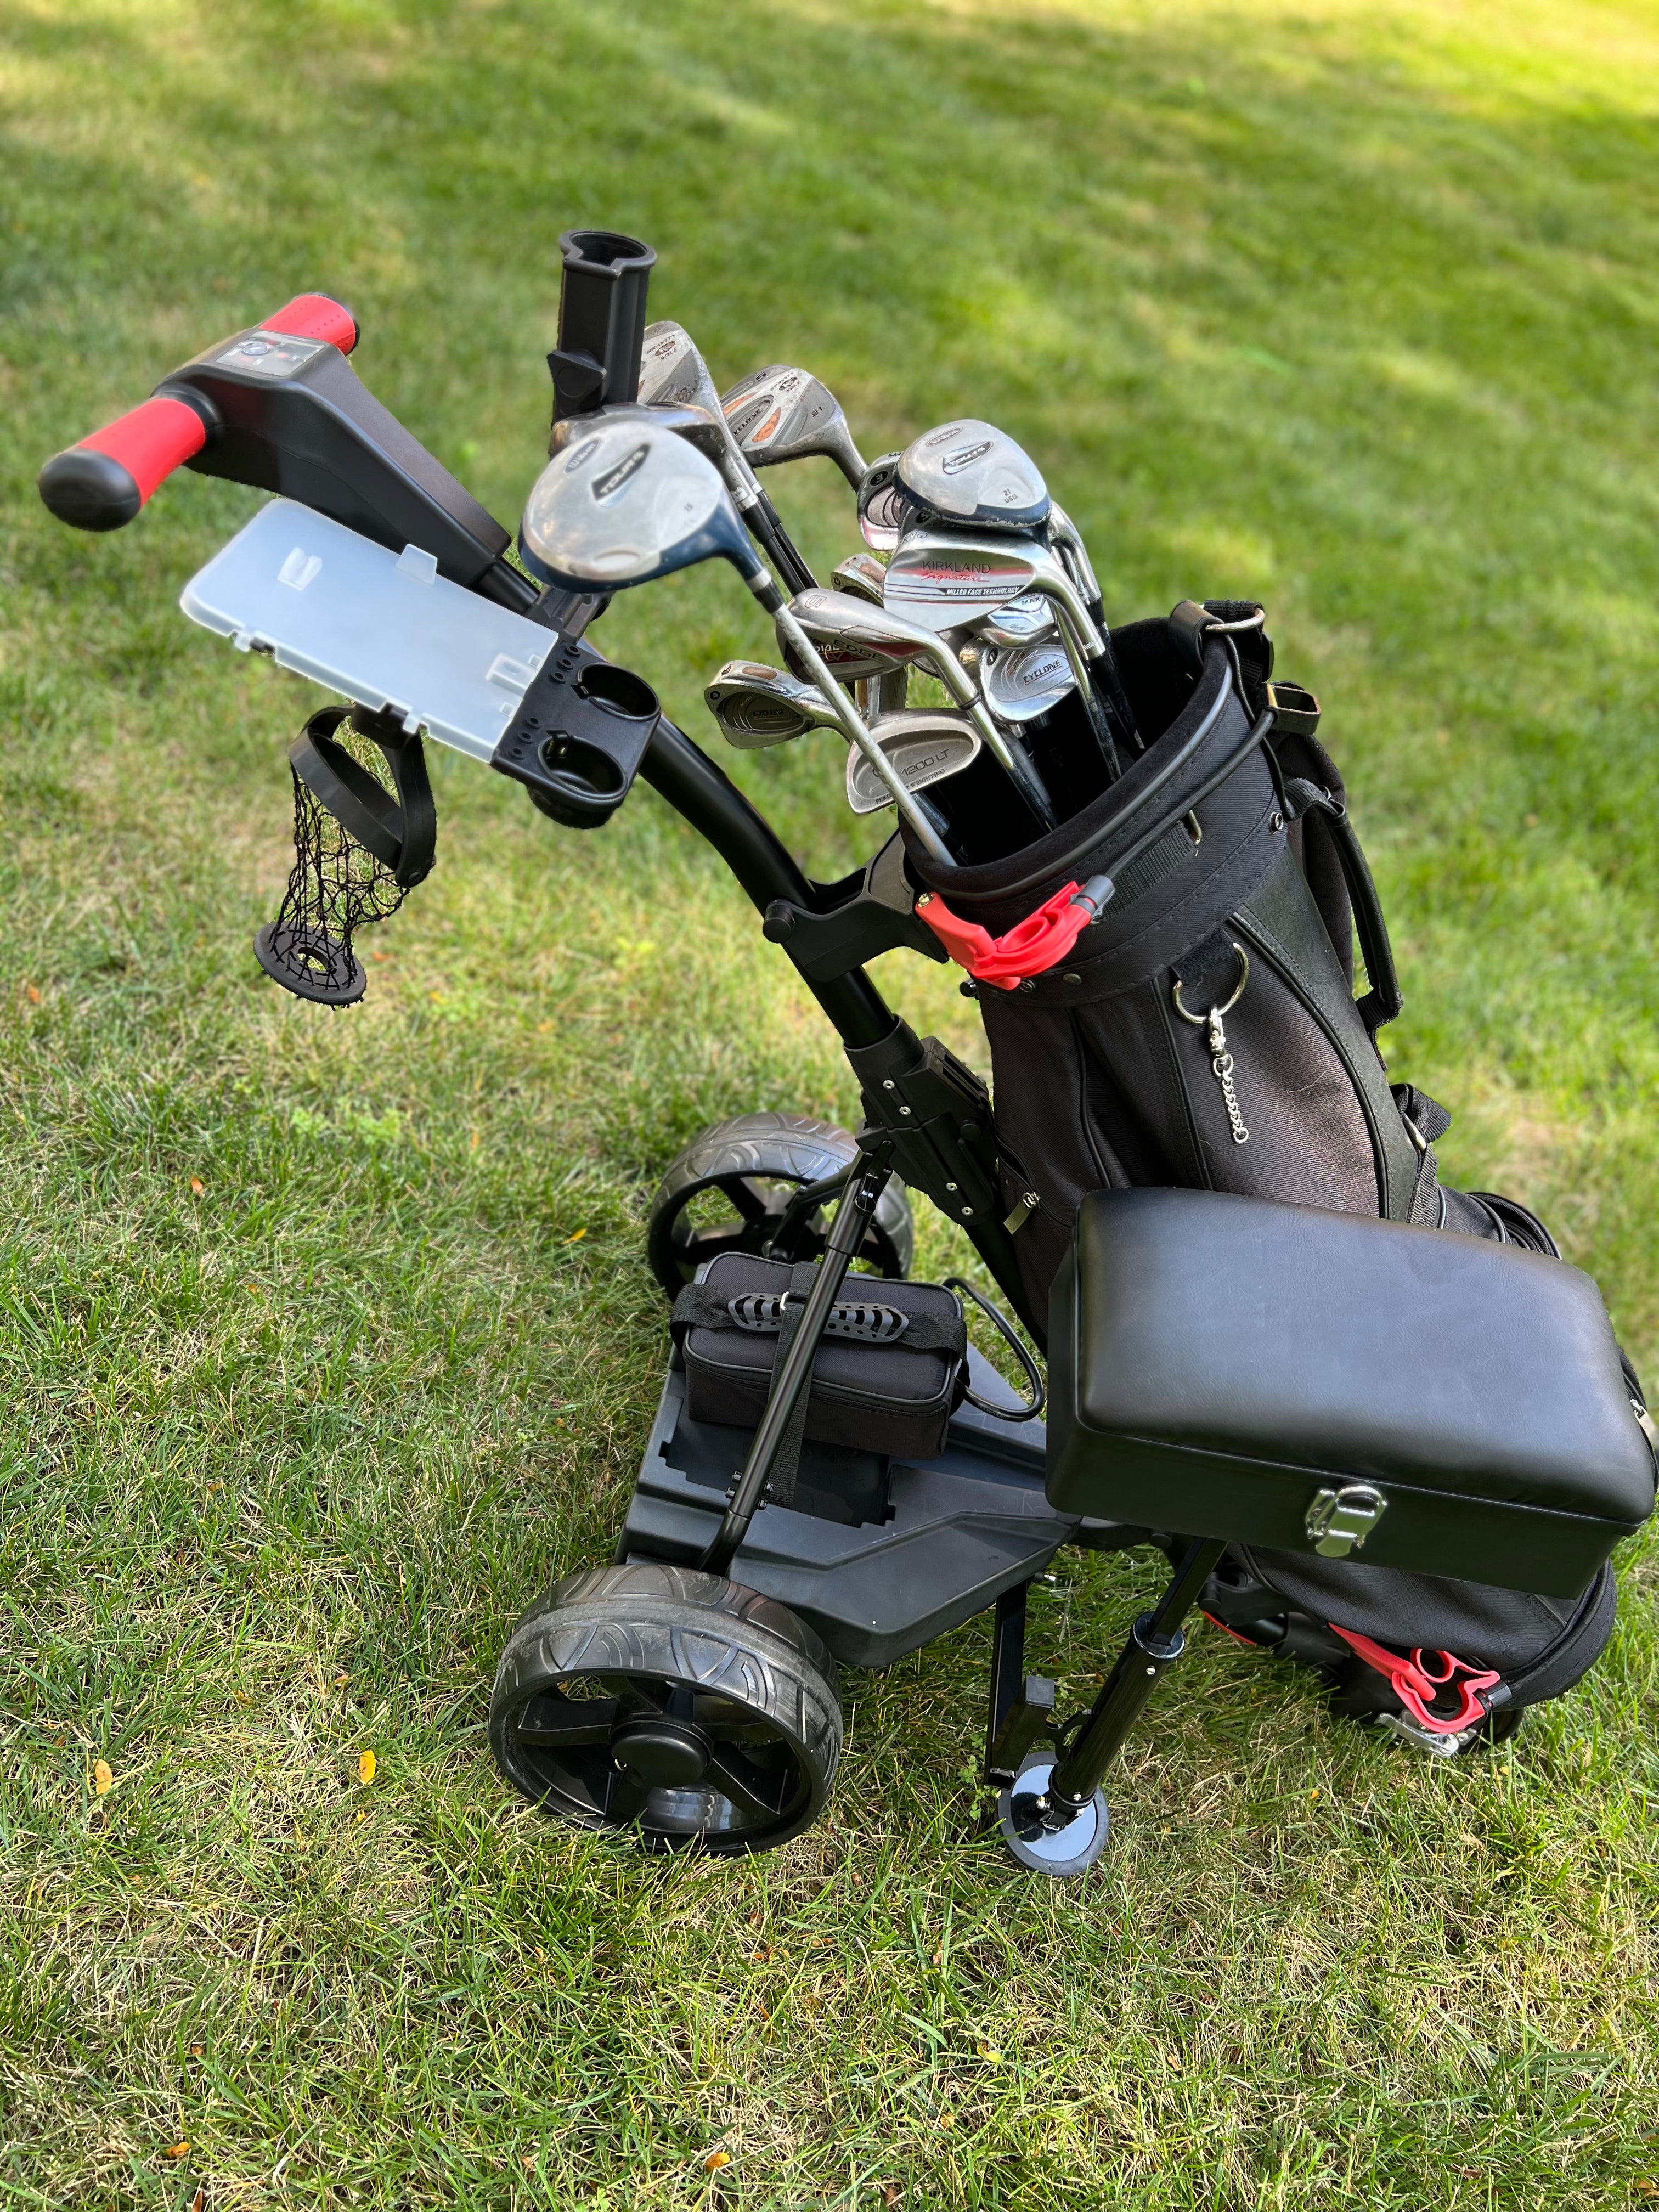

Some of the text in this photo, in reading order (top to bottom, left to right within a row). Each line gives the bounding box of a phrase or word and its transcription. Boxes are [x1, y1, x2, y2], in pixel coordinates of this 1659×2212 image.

[647, 333, 676, 354] GRAVITY
[660, 347, 677, 360] SOLE
[770, 371, 794, 391] GRAVITY
[786, 380, 800, 392] SOLE
[811, 406, 823, 418] 21
[733, 408, 761, 436] YCLONE
[928, 429, 959, 445] Wilson
[1002, 488, 1011, 496] 21
[1003, 494, 1018, 503] DEG
[922, 561, 991, 574] KIRKLAND
[921, 571, 990, 584] Signature
[1022, 596, 1041, 606] MAX
[833, 639, 885, 663] EDGE
[1023, 660, 1061, 684] CYCLONE
[901, 749, 949, 776] 1200 LT
[910, 769, 945, 788] WEIGHTING
